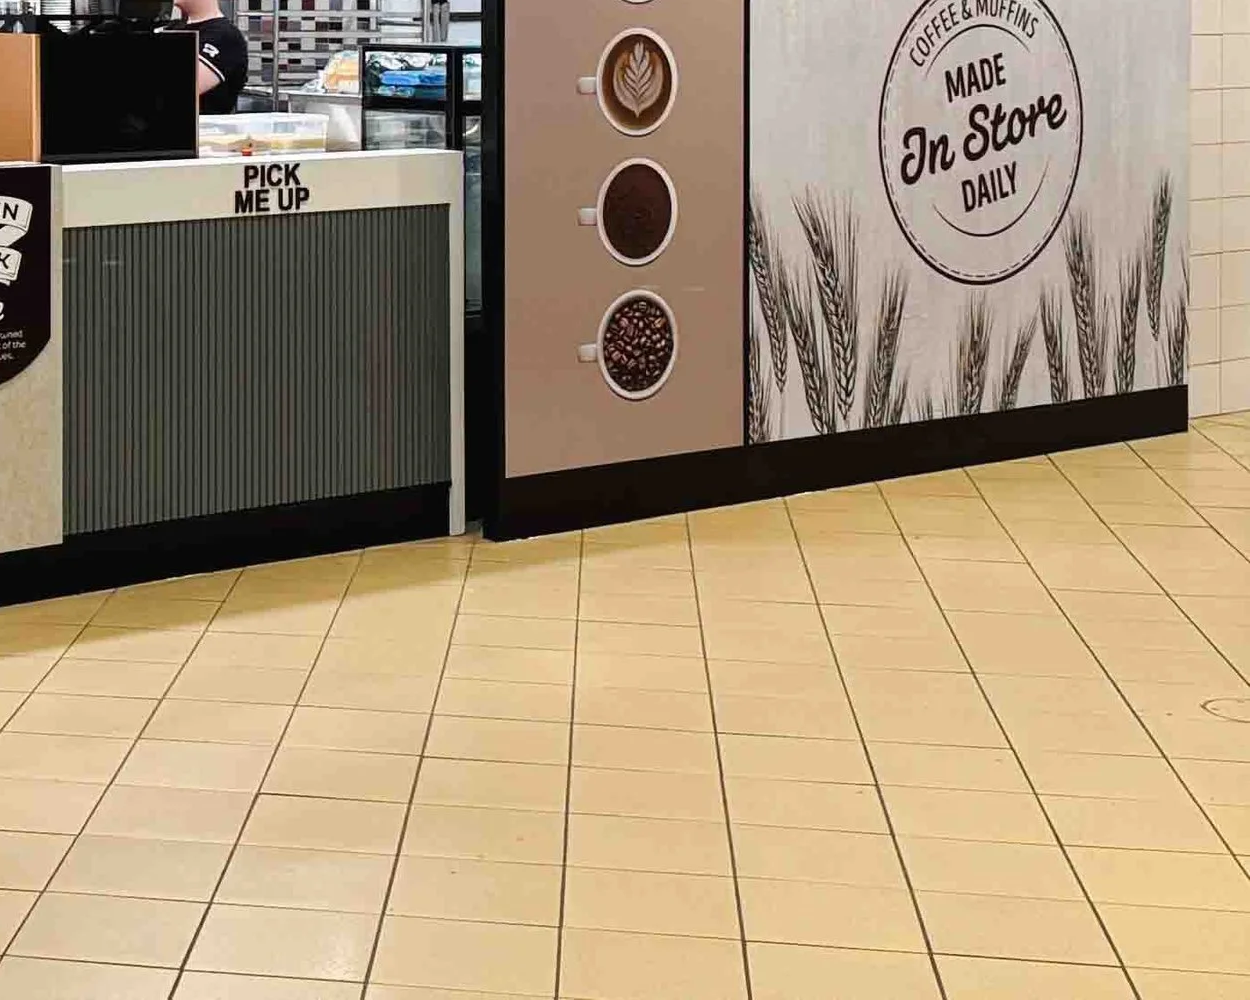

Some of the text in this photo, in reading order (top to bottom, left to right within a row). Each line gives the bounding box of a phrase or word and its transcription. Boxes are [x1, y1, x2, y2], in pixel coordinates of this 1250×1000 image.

[909, 2, 960, 67] COFFEE
[944, 52, 1007, 103] MADE
[901, 93, 1067, 185] In Store
[235, 187, 310, 214] ME UP
[244, 163, 301, 188] PICK
[960, 161, 1017, 213] DAILY
[2, 341, 11, 350] of
[12, 340, 27, 349] the
